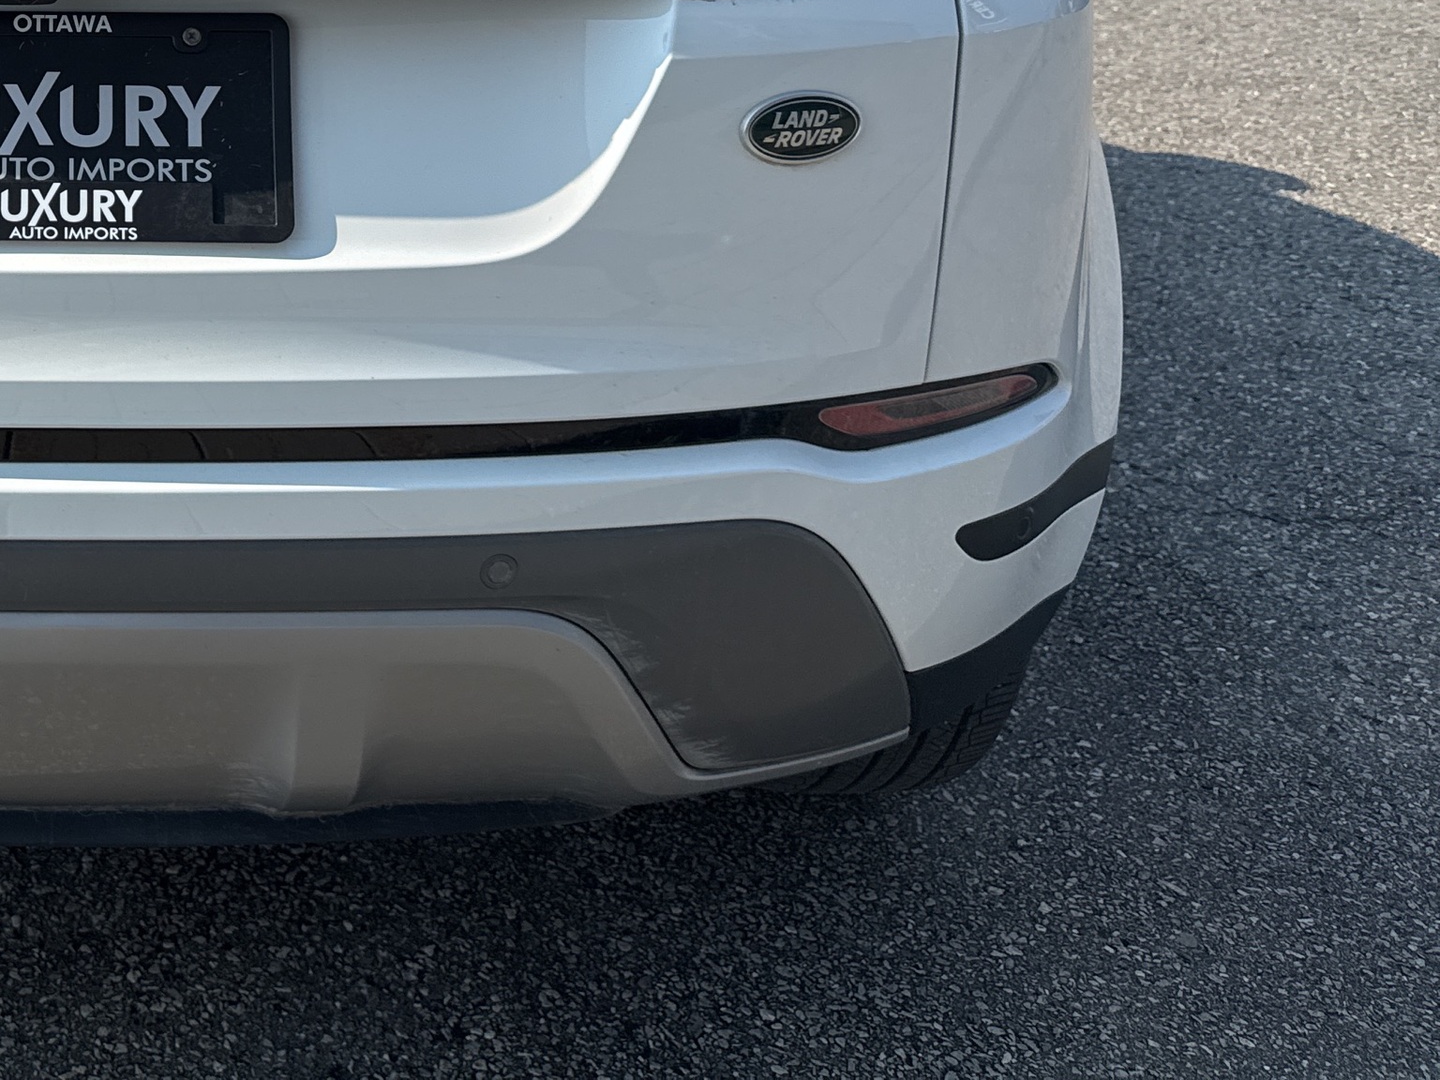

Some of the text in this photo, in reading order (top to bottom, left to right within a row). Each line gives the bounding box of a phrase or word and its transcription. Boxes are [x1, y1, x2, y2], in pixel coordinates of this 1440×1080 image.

[13, 14, 113, 33] OTTAWA
[67, 159, 213, 182] IMPORTS
[9, 226, 138, 241] AUTO IMPORTS
